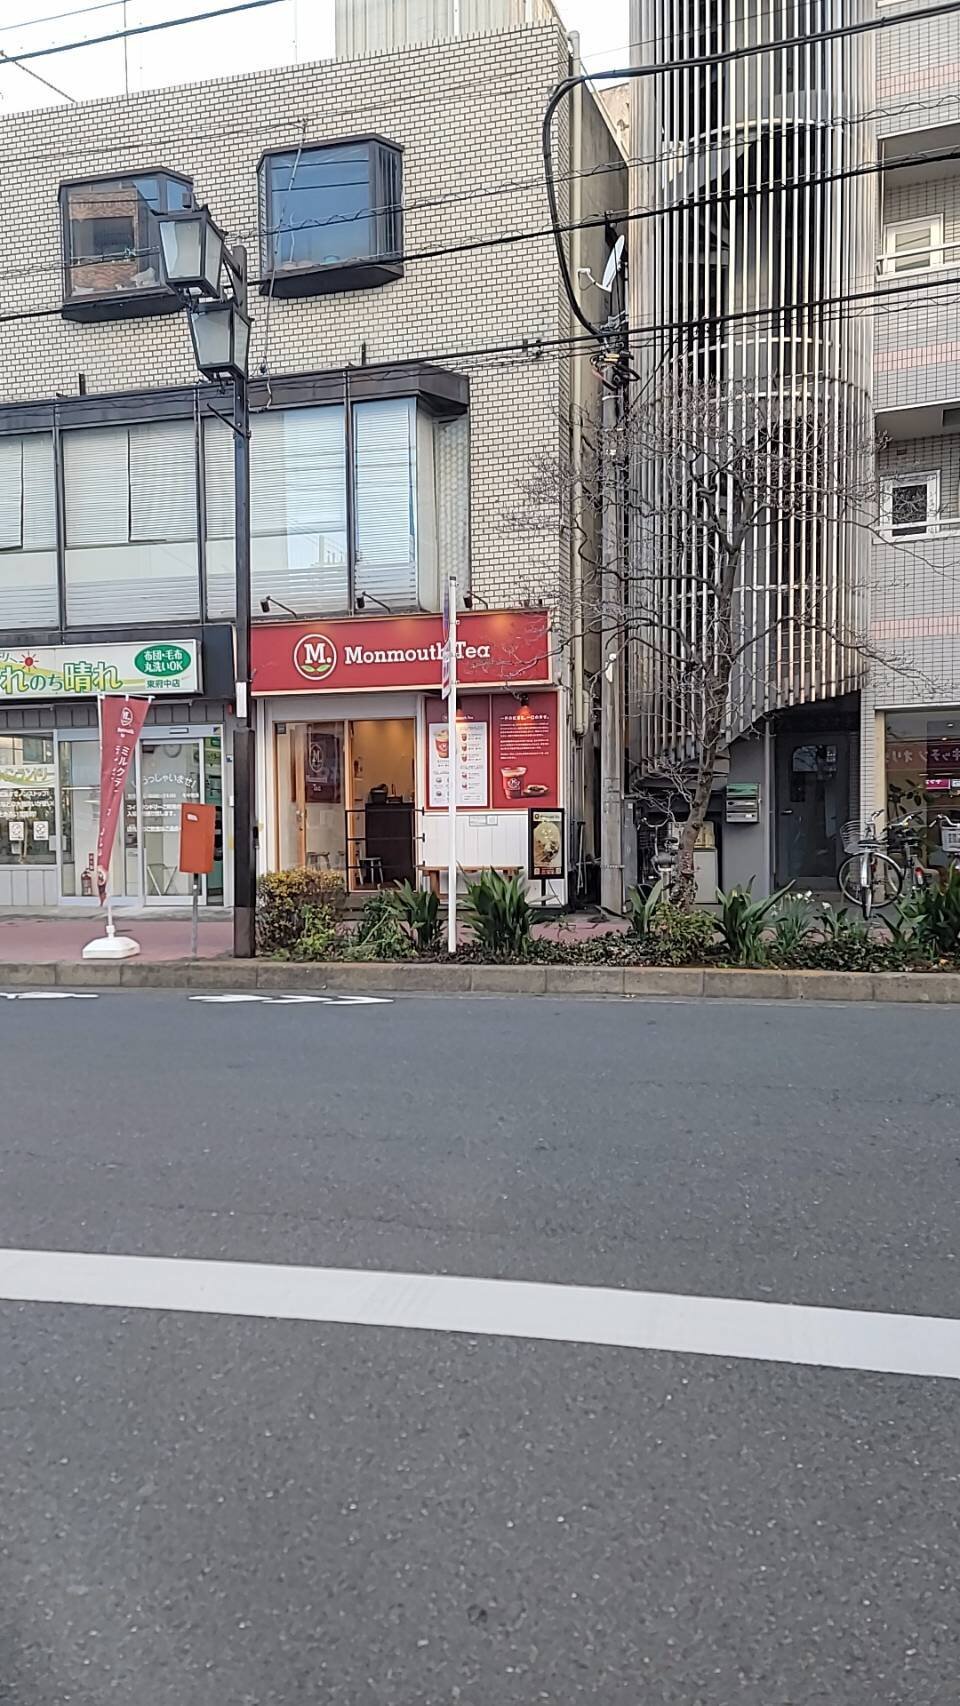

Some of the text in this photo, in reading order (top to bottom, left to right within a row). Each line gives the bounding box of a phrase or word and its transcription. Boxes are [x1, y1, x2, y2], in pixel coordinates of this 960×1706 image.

[456, 641, 491, 659] Tea
[143, 661, 183, 672] 丸洗いOK
[147, 679, 181, 689] 東府中店
